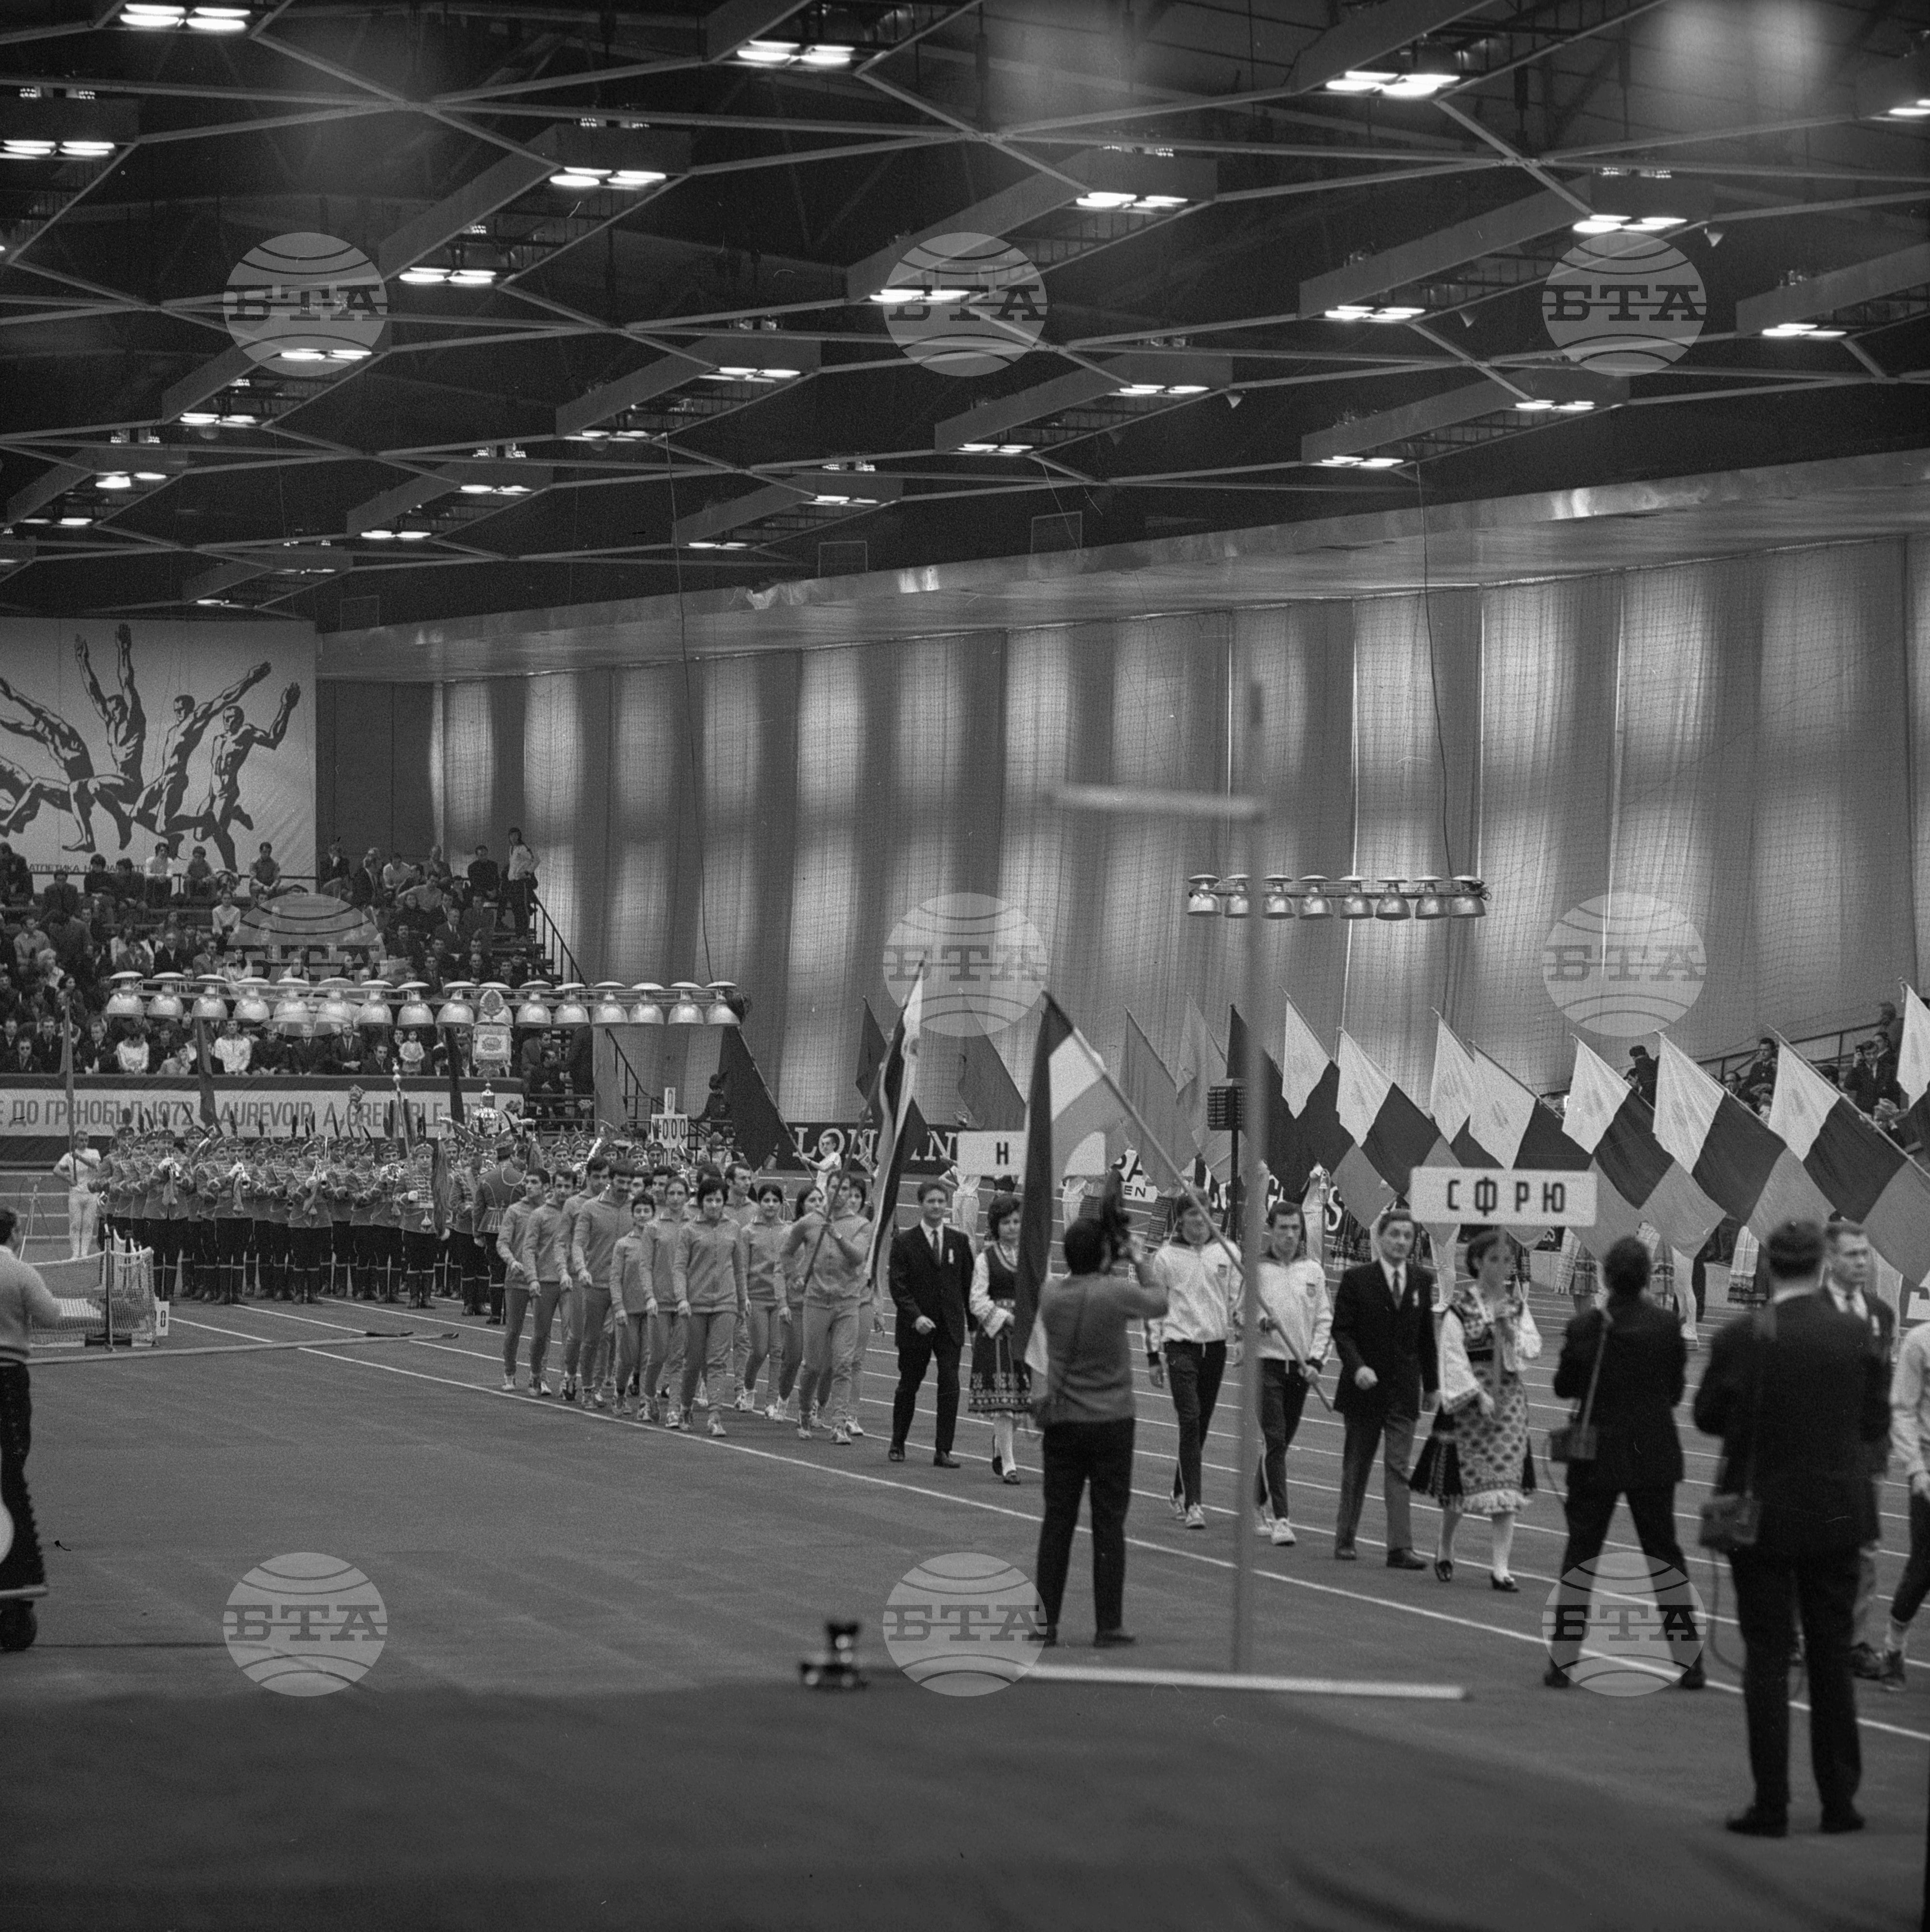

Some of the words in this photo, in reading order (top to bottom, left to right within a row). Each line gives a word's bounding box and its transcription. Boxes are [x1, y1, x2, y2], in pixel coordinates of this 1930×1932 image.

[9, 1100, 39, 1127] ДО
[45, 1100, 143, 1128] ГРНОБЪЛ
[1448, 1177, 1565, 1216] СФРЮ
